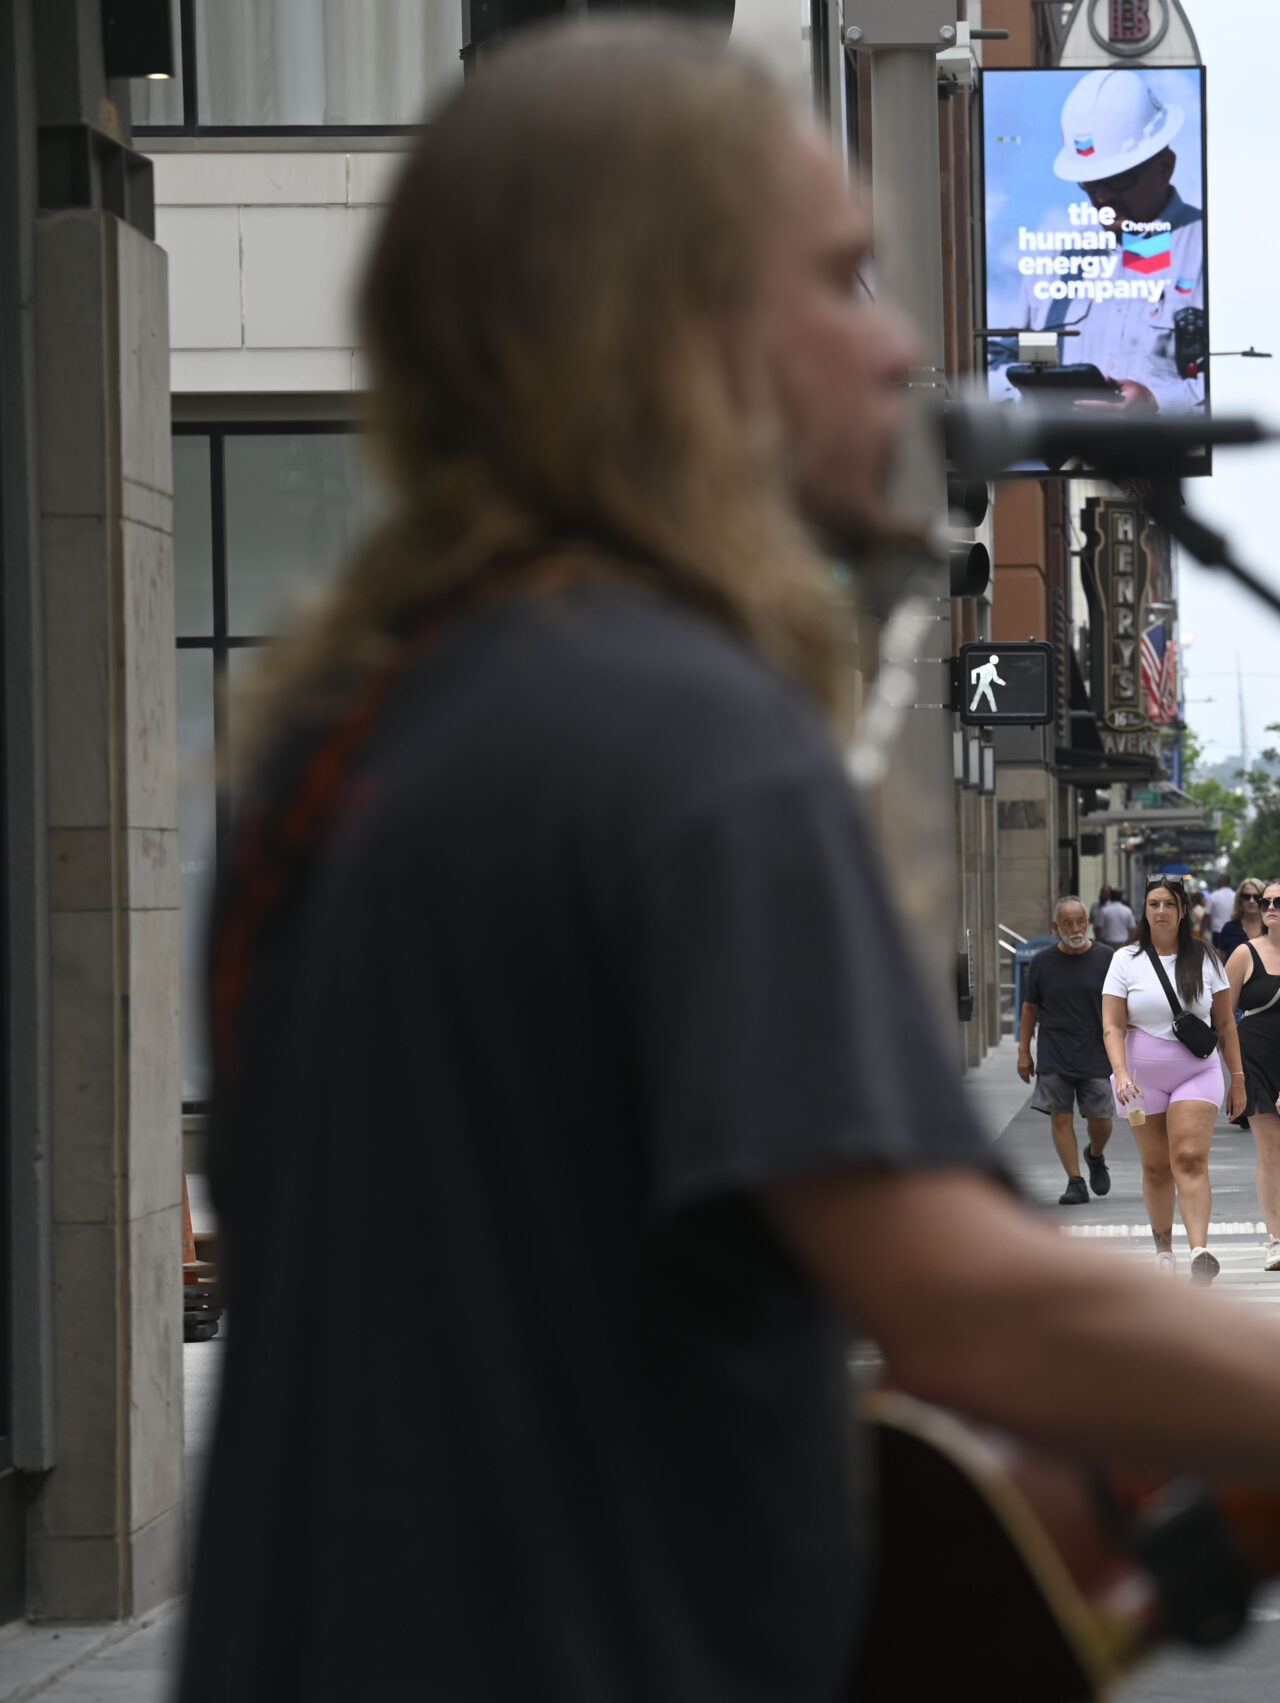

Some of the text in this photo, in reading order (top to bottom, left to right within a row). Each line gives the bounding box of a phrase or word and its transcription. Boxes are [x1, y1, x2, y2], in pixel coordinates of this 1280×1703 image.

[1108, 0, 1150, 42] B
[1068, 201, 1116, 226] the
[1121, 219, 1171, 232] Chevron
[1018, 226, 1117, 250] human
[1018, 255, 1118, 279] energy
